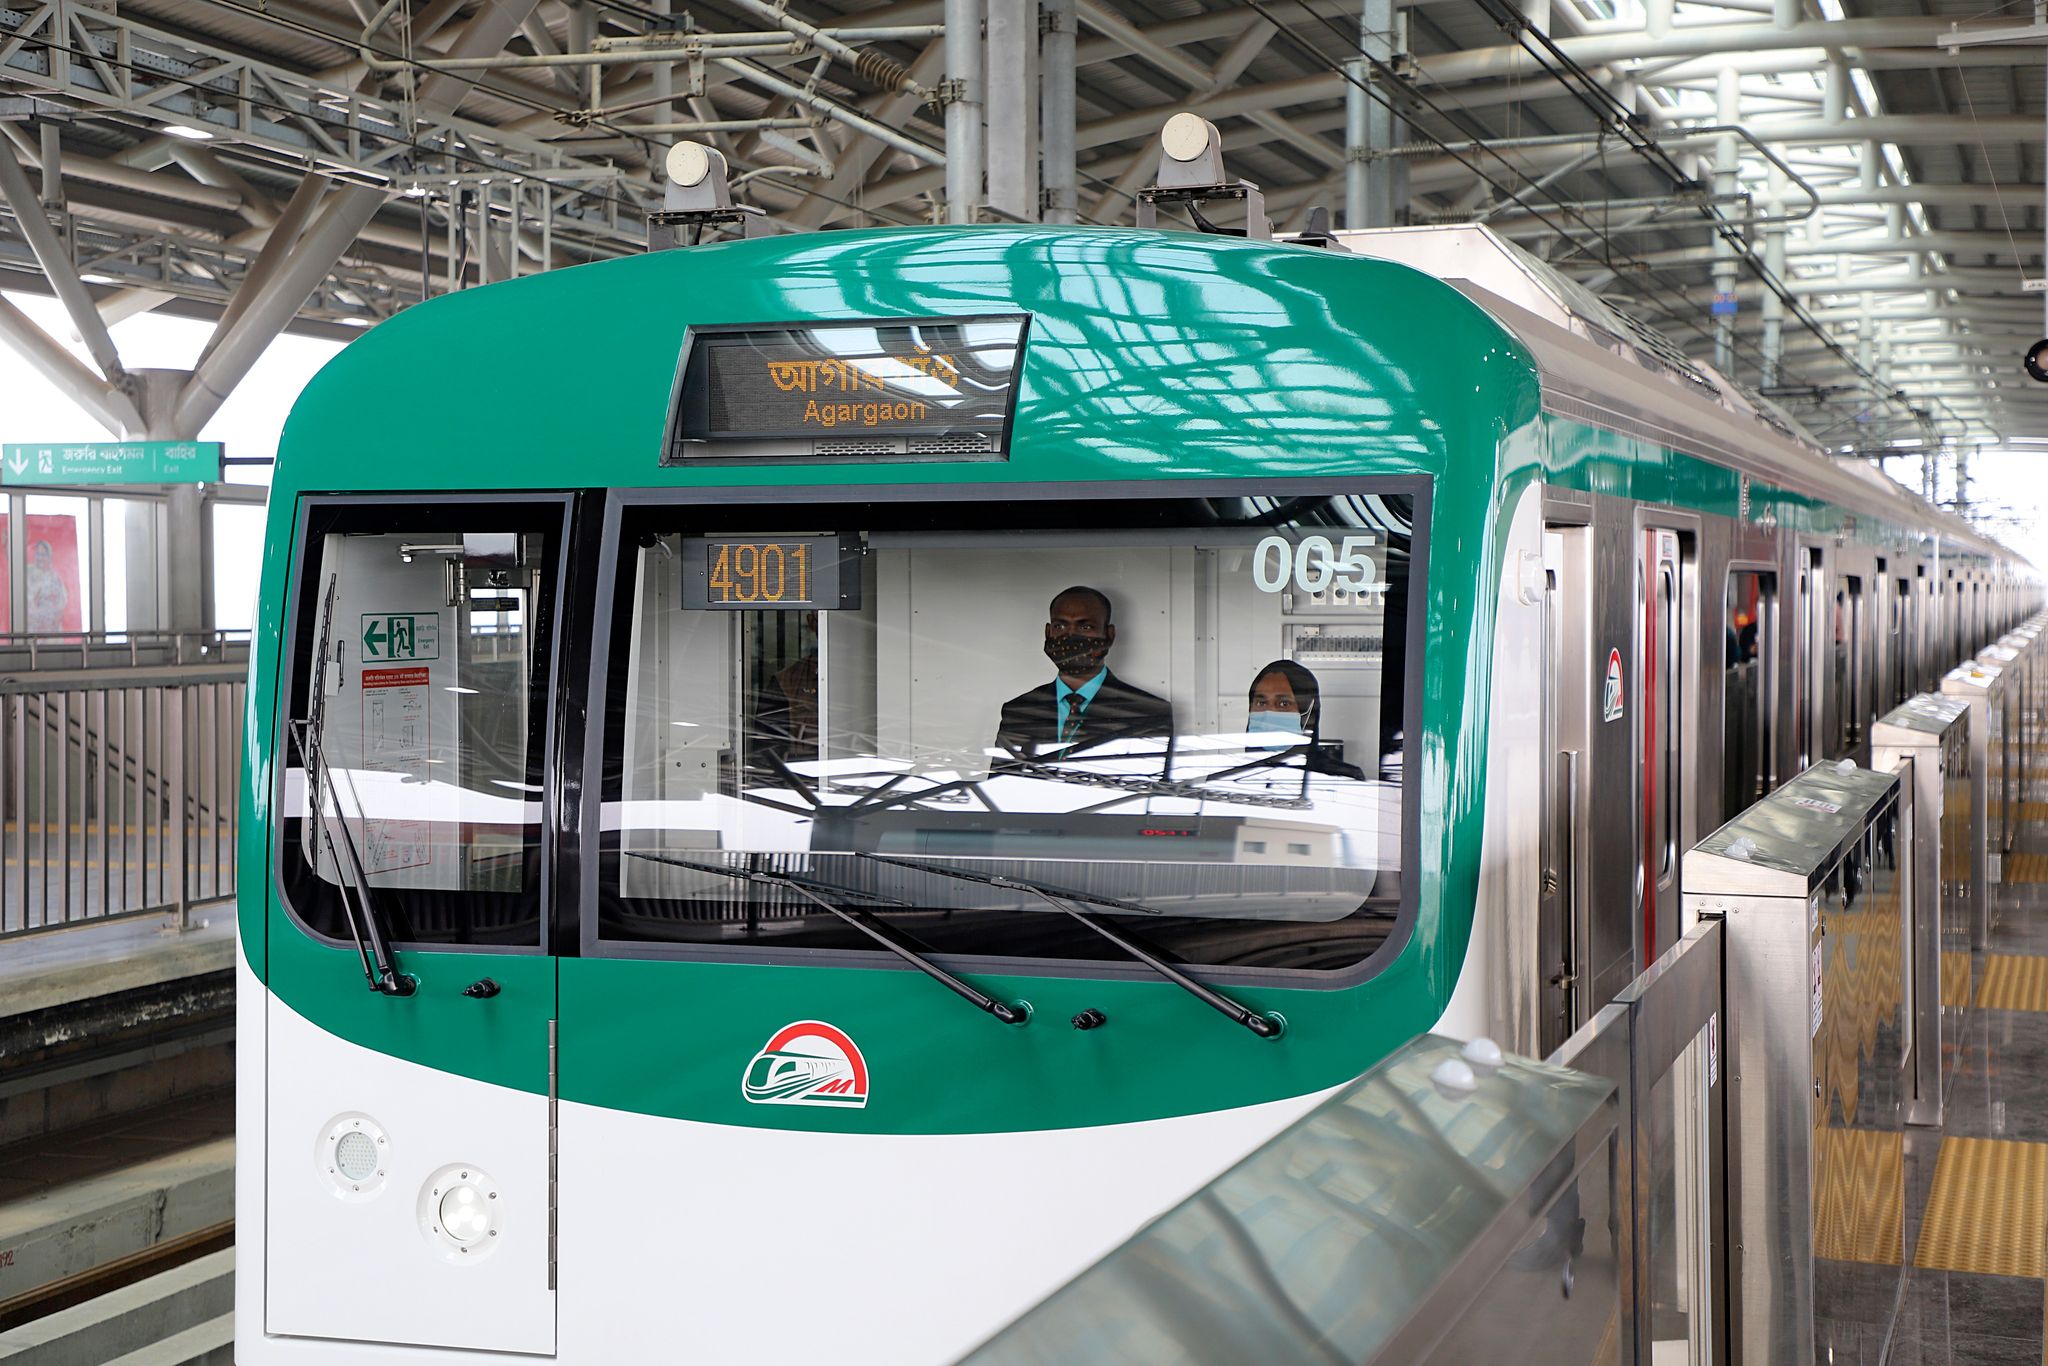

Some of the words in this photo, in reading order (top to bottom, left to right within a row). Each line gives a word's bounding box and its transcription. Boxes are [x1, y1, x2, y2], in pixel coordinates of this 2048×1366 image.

[803, 400, 926, 427] Agargaon
[62, 466, 104, 475] Emergency
[107, 465, 122, 474] Exit
[164, 465, 179, 473] Exit
[710, 543, 808, 602] 4901
[1254, 536, 1376, 592] 005
